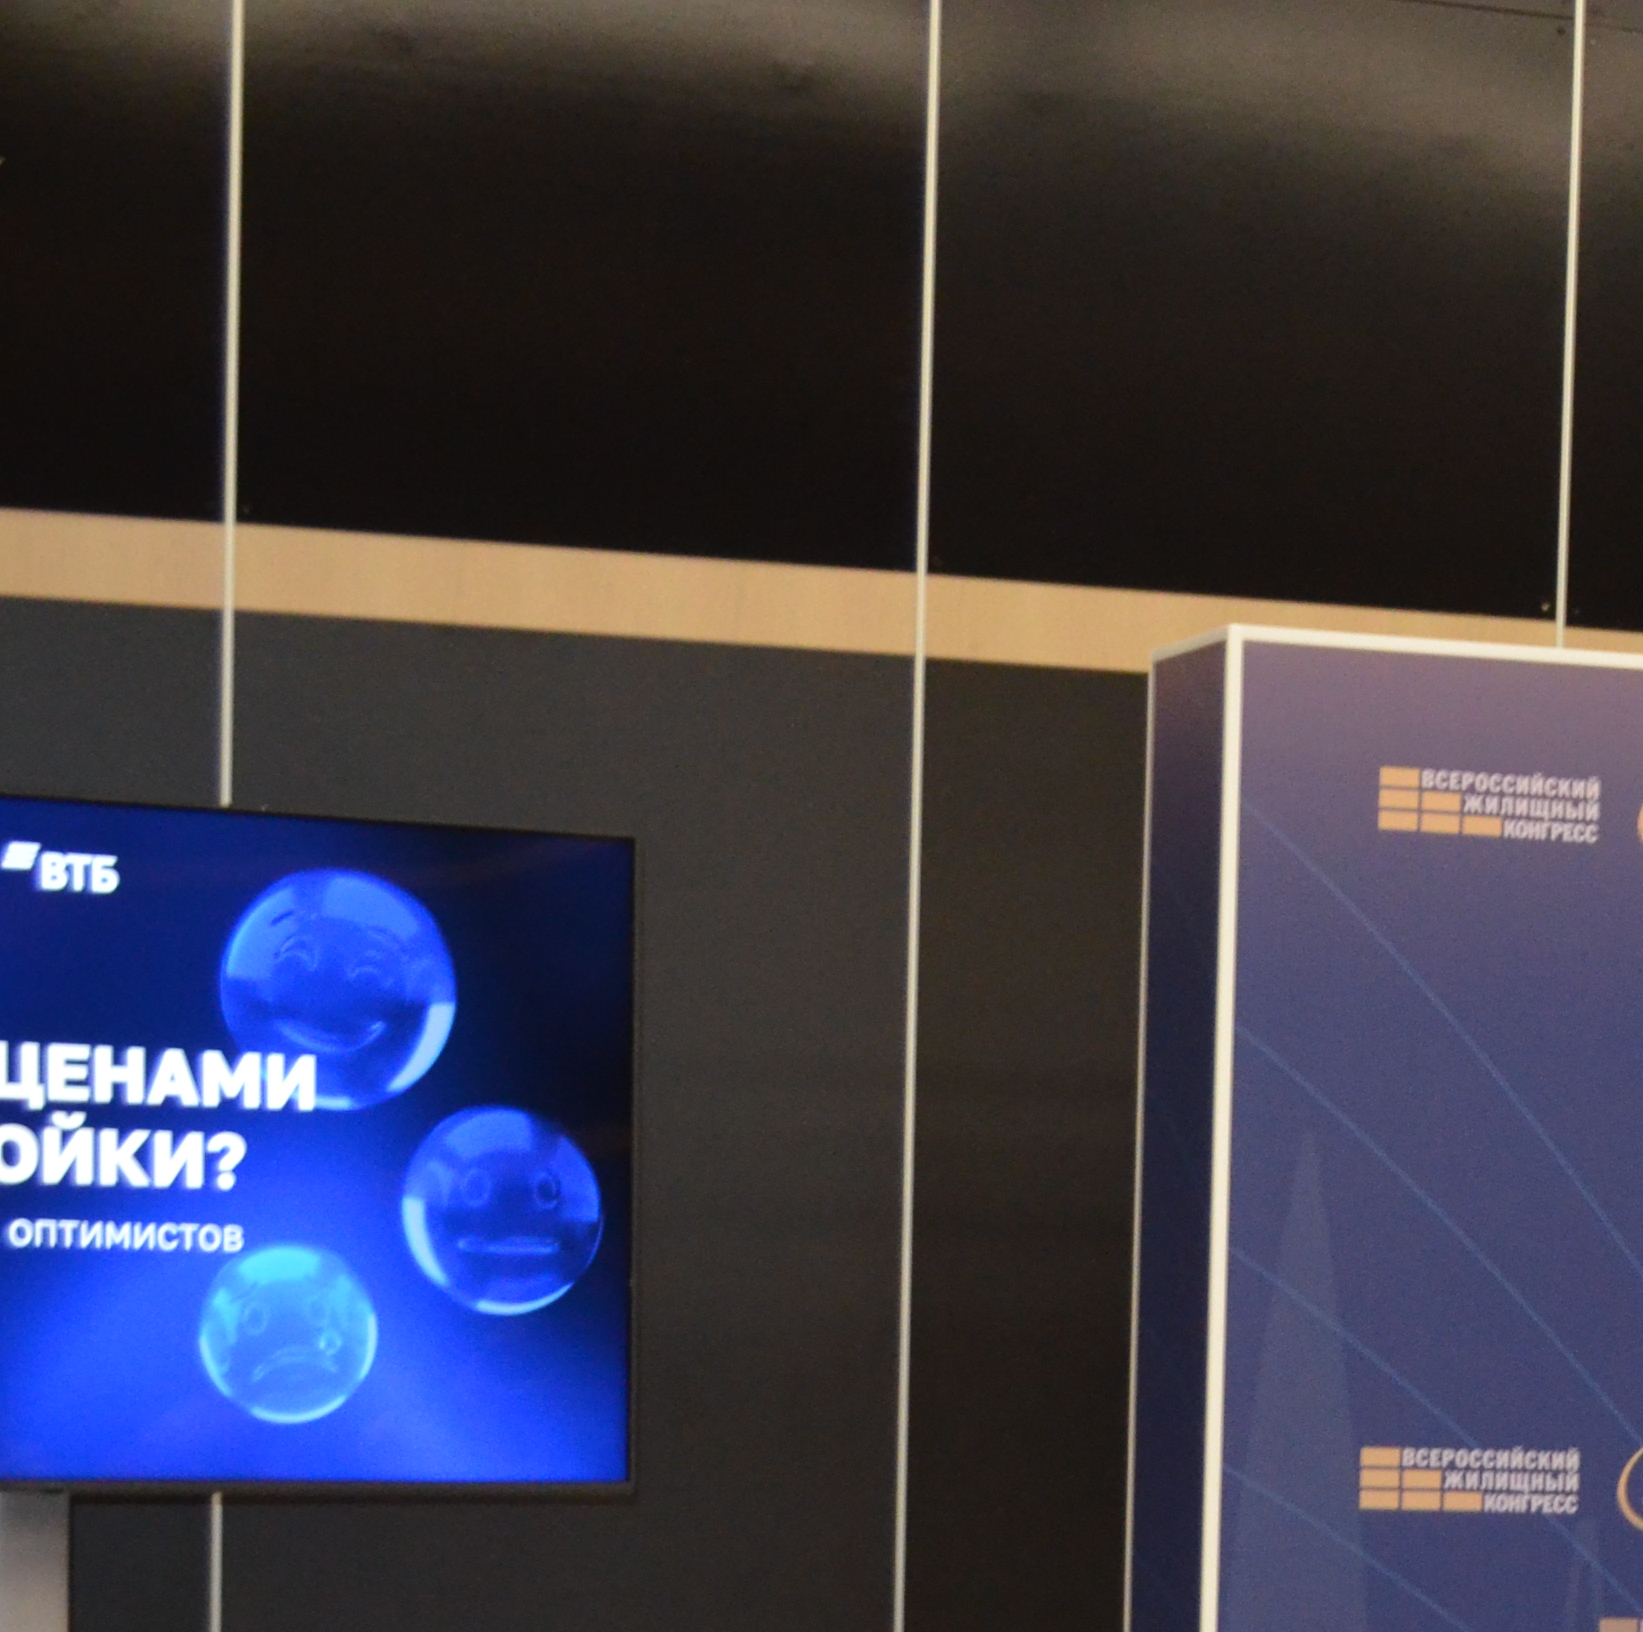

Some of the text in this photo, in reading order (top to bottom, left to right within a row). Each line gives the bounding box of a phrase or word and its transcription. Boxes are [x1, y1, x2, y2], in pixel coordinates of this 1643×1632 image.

[1420, 769, 1600, 799] ВСЕРОССИЙСКИЙ
[1462, 794, 1600, 821] ЖИЛИЩНЫЙ
[1502, 817, 1598, 844] КОНГРЕСС
[40, 852, 120, 894] ВТБ
[7, 1217, 245, 1253] ОПТИМИСТОВ
[1400, 1446, 1581, 1471] ВСЕРОССИЙСКИЙ
[1442, 1468, 1580, 1492] ЖИЛИЩНЫЙ
[1482, 1492, 1579, 1515] КОНГРЕСС
